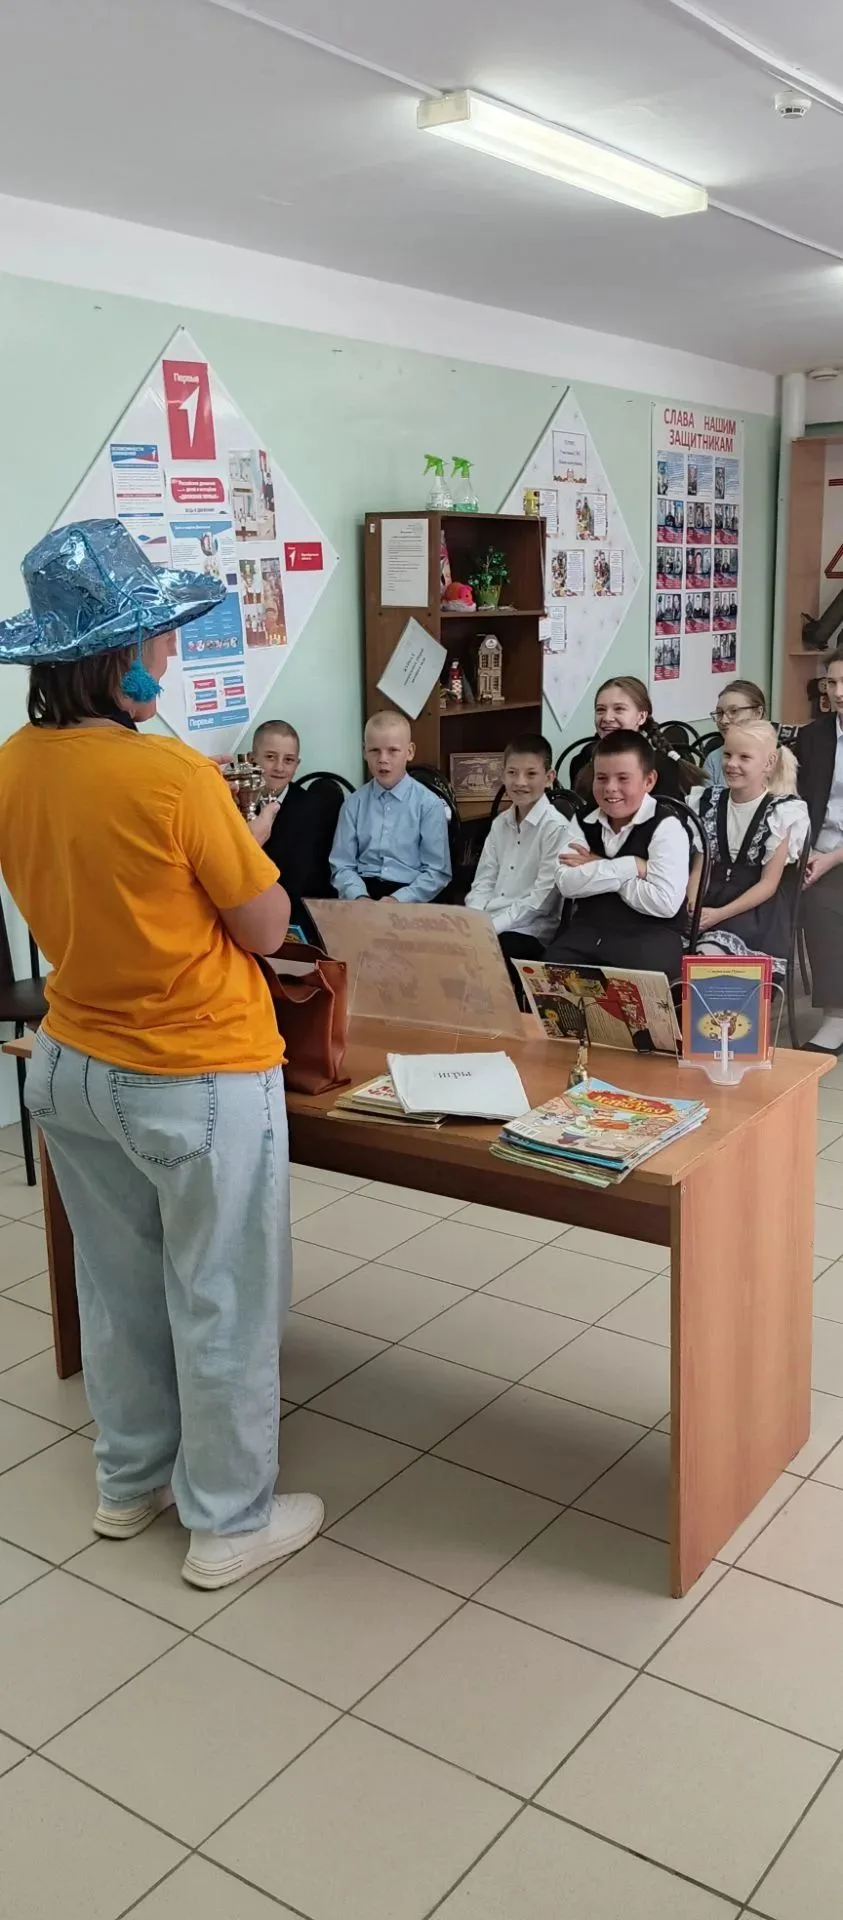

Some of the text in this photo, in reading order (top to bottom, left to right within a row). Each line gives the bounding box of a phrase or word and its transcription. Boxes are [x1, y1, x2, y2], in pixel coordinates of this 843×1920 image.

[173, 372, 200, 385] Первые
[663, 408, 737, 436] СЛАВА НАШИМ
[669, 428, 734, 453] ЗАЩИТНИКАМ
